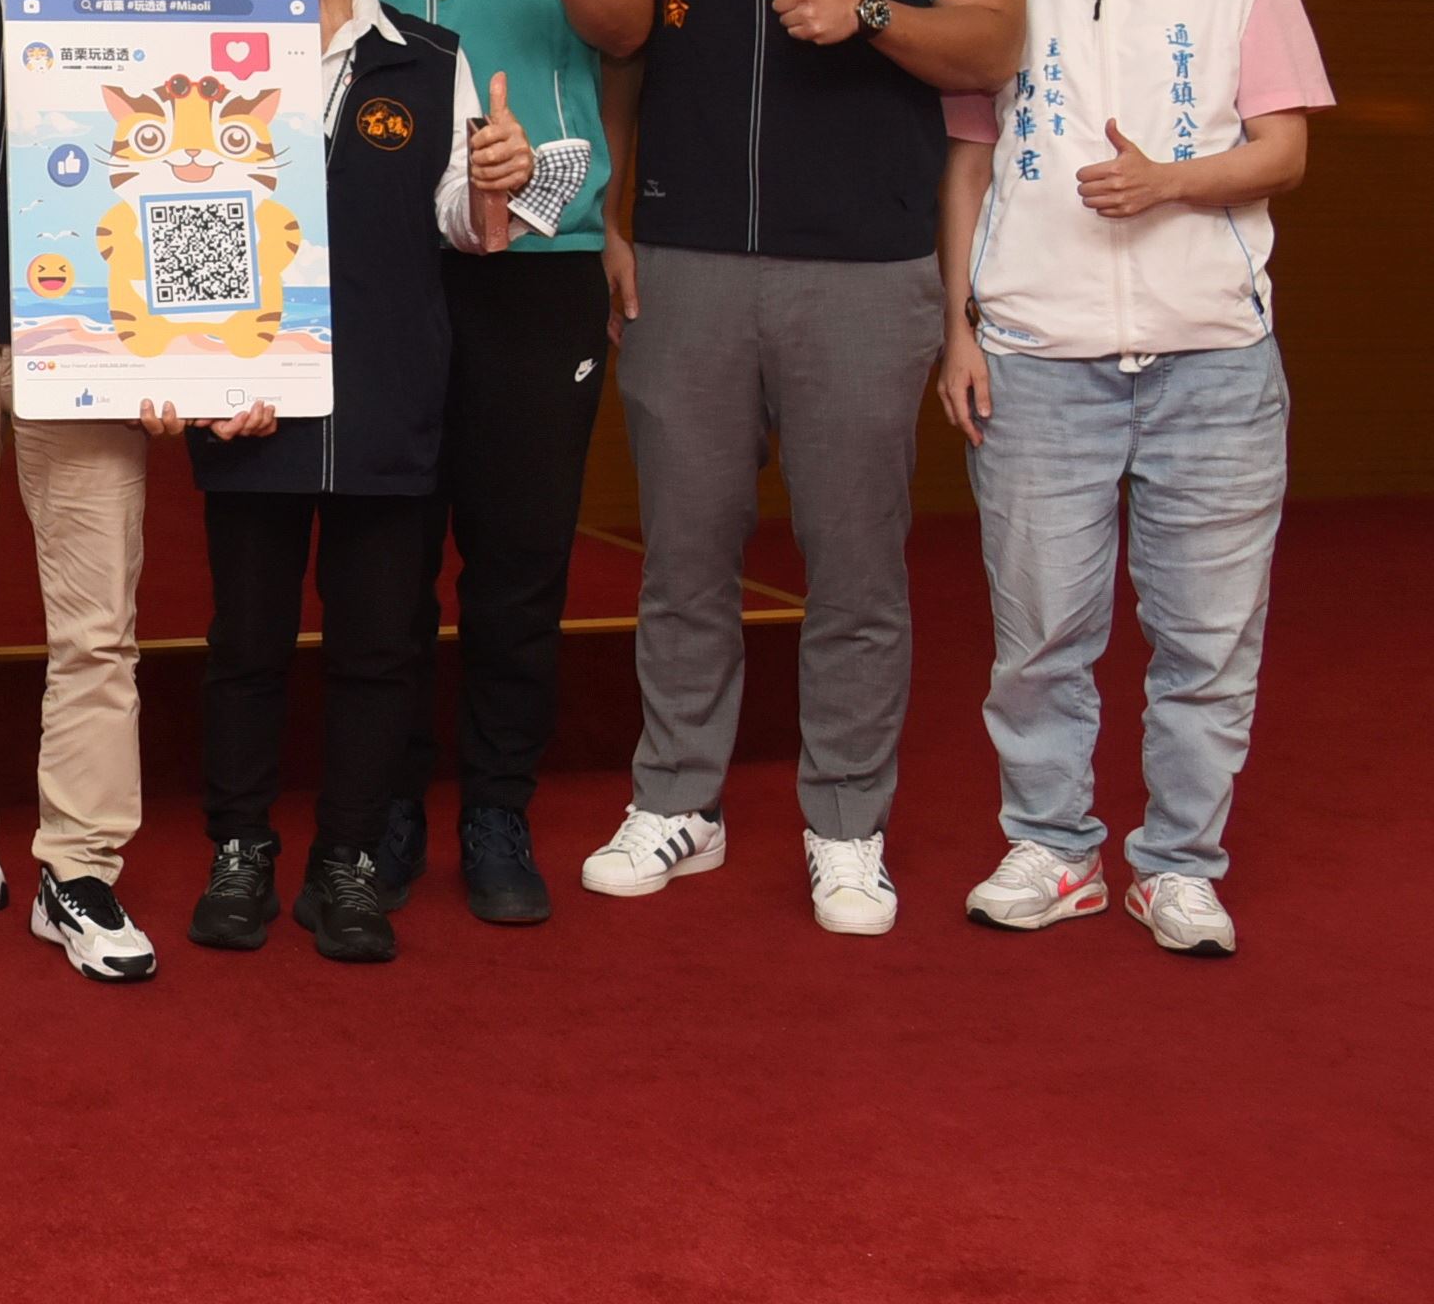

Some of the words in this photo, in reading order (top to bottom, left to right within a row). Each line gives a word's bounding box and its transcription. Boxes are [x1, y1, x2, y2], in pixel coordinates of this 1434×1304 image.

[169, 0, 212, 12] #Miaoli
[60, 47, 129, 61] 苗栗玩透透
[1043, 38, 1066, 136] 主任秘書
